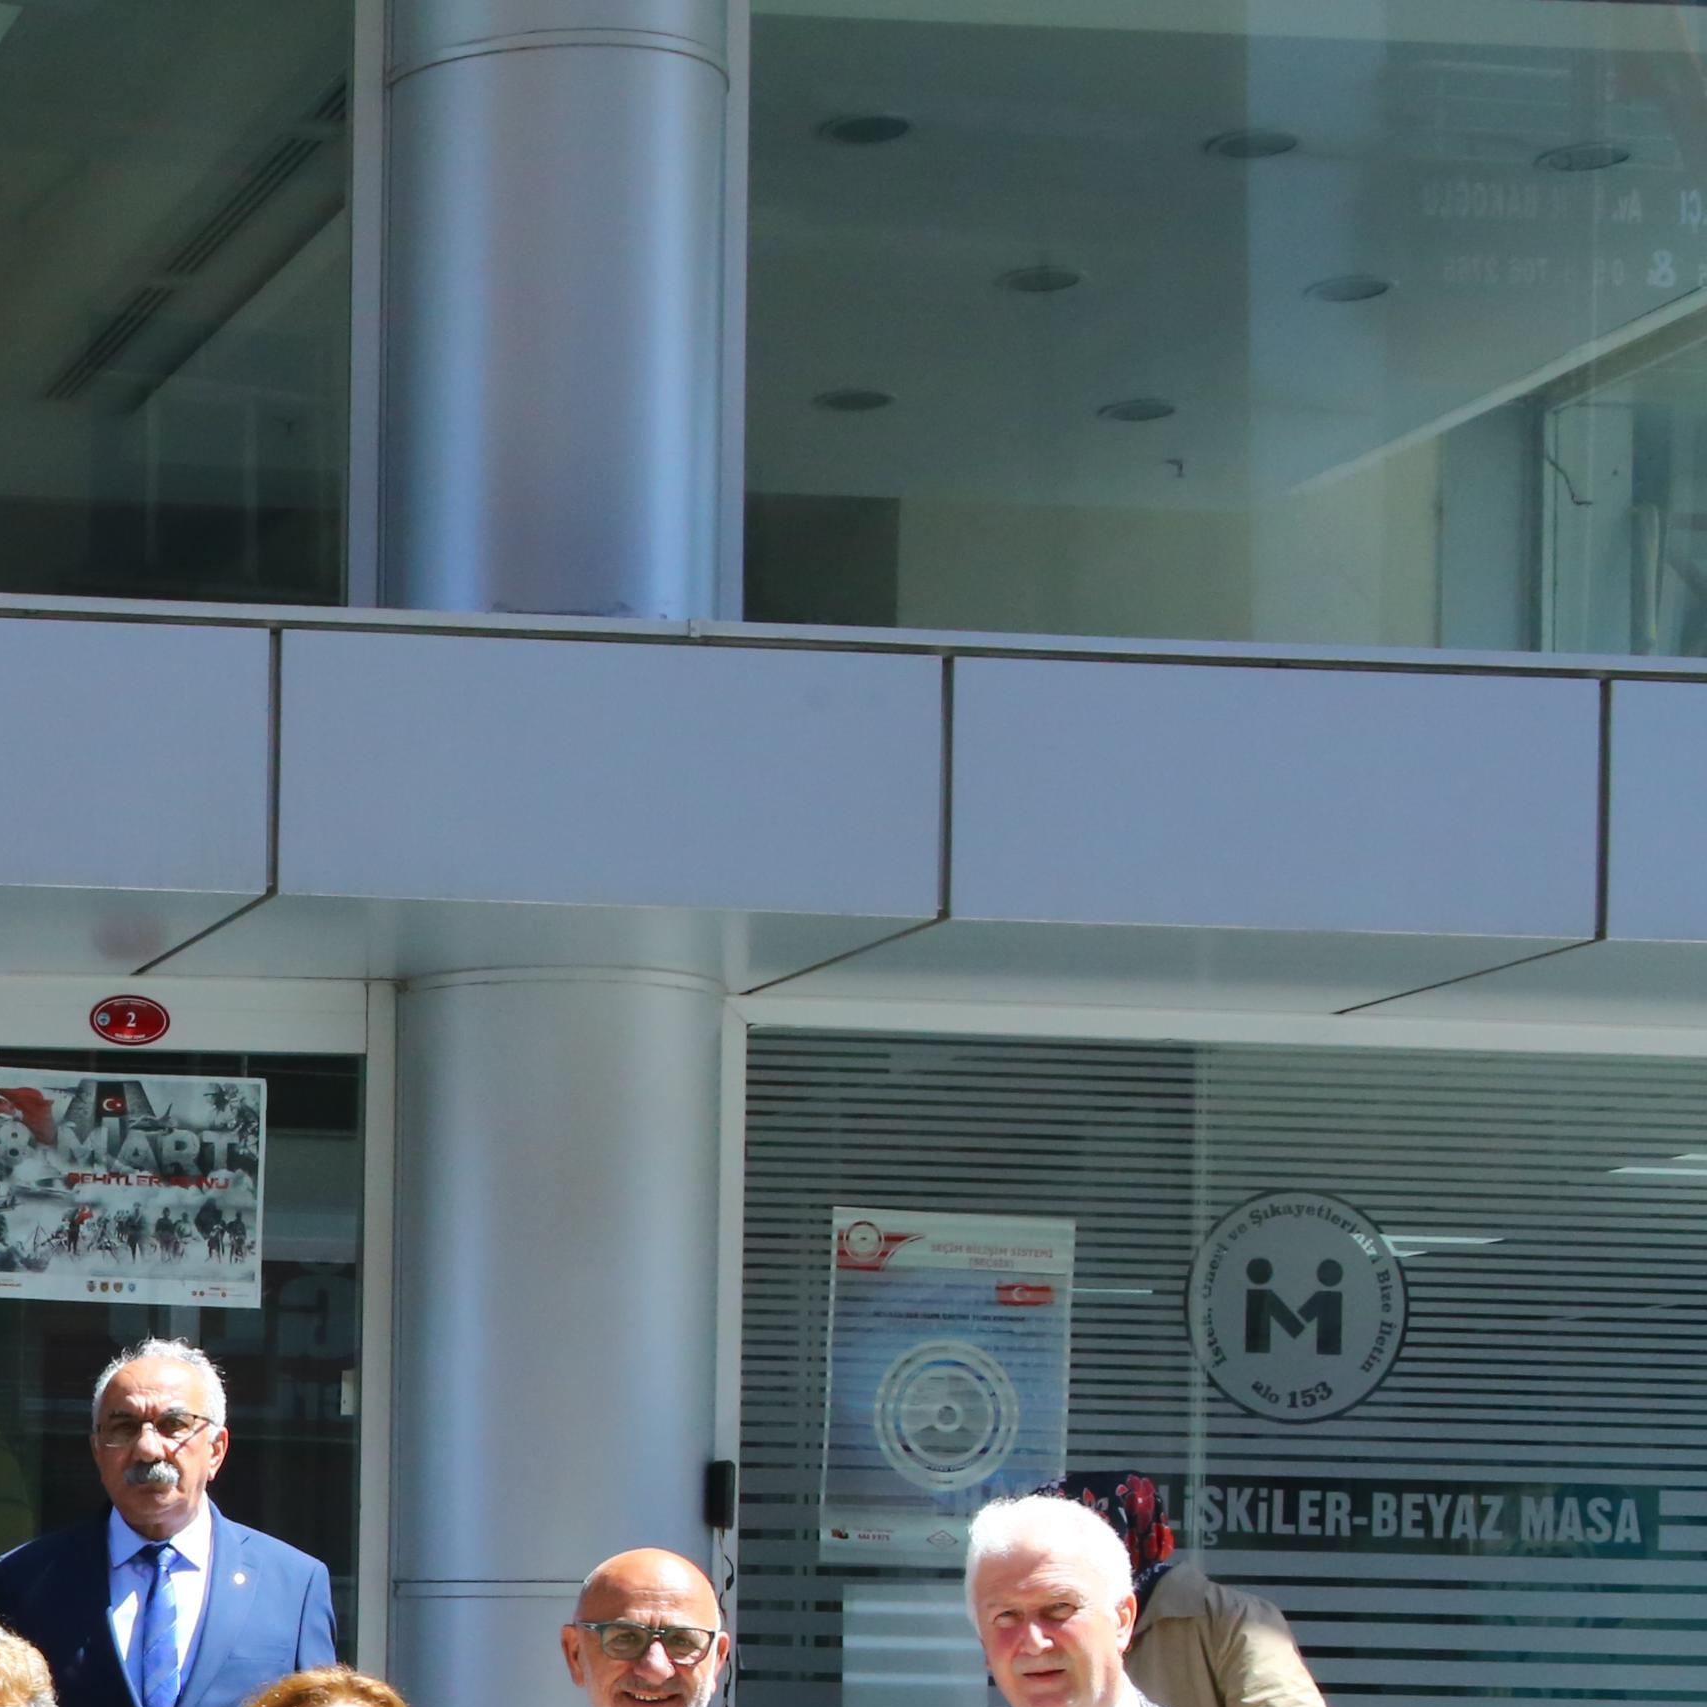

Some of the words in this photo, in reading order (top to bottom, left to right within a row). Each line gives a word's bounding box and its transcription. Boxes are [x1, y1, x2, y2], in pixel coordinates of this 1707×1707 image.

[127, 1011, 137, 1028] 2
[57, 1120, 241, 1174] MART
[1228, 1221, 1248, 1241] ve
[1376, 1268, 1393, 1314] Bize
[1251, 1381, 1280, 1405] alo
[1287, 1381, 1334, 1409] 153
[1520, 1496, 1641, 1544] MASA
